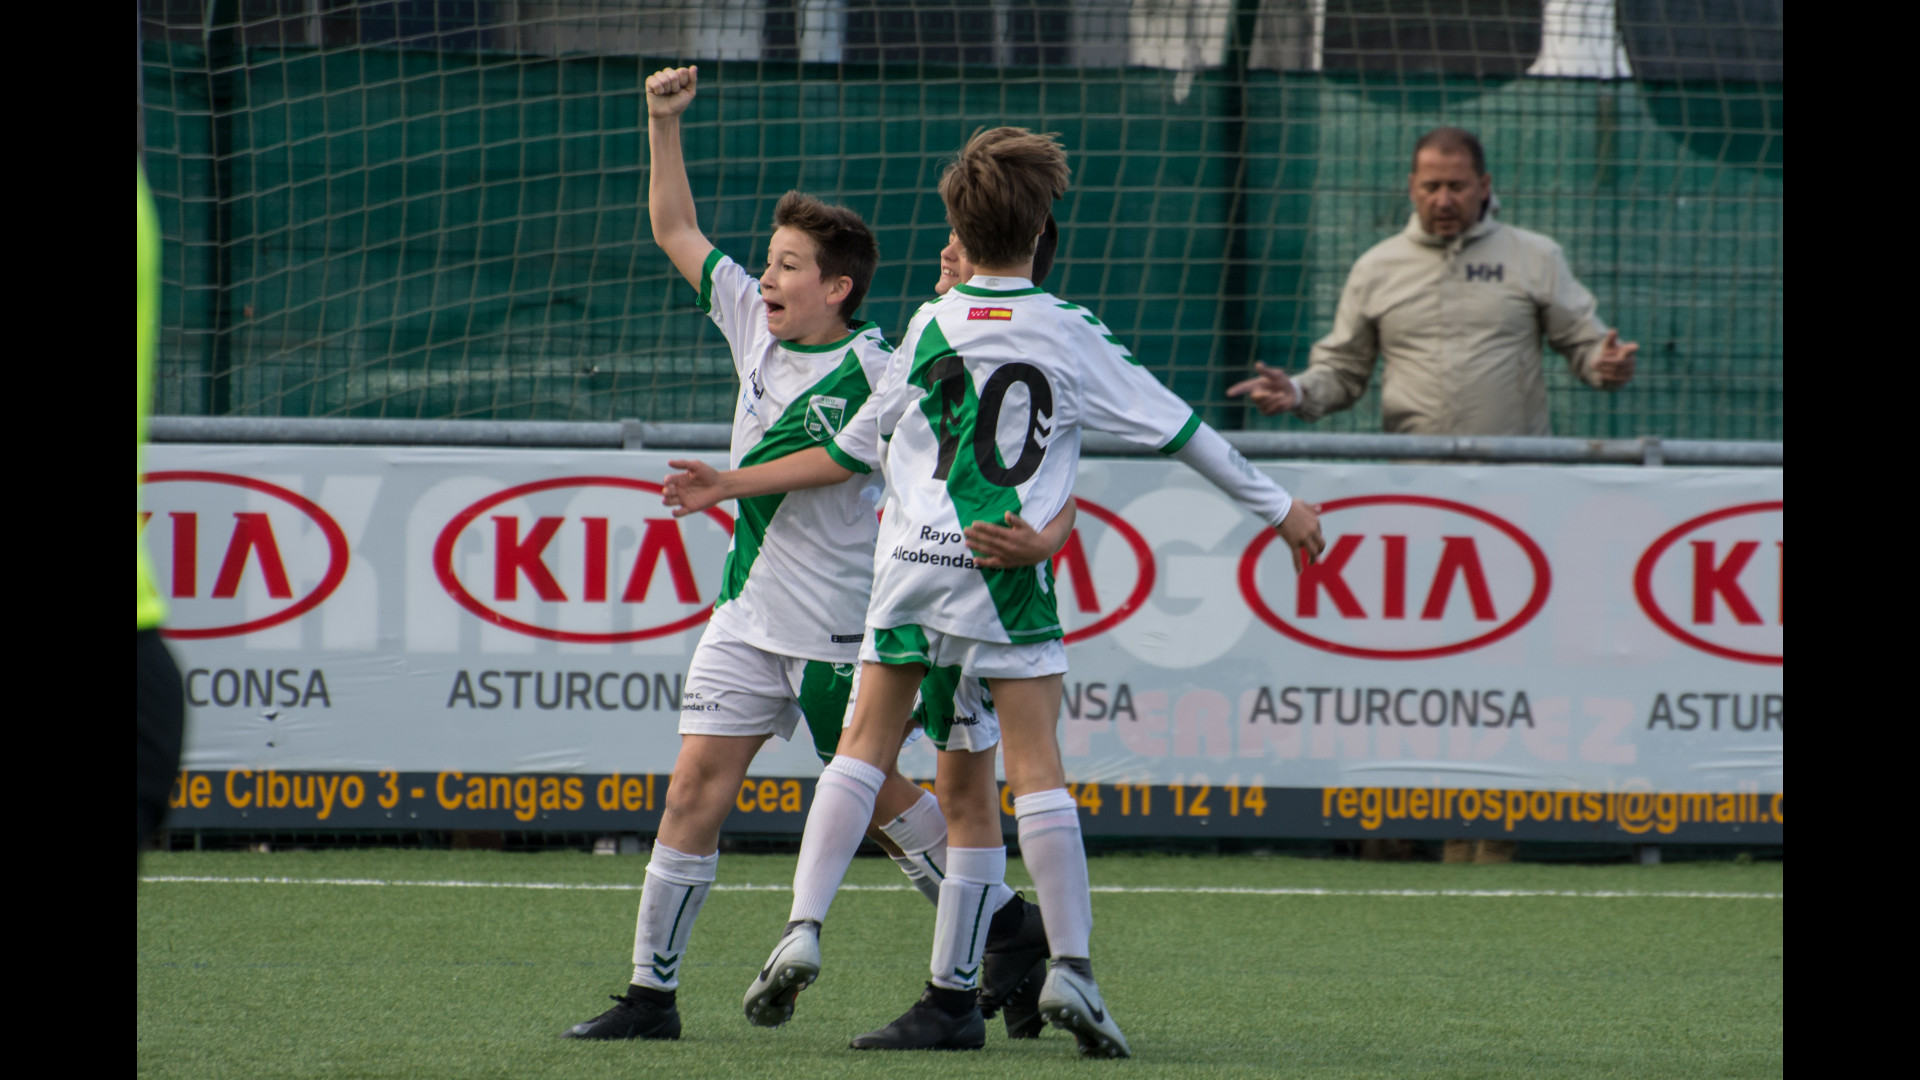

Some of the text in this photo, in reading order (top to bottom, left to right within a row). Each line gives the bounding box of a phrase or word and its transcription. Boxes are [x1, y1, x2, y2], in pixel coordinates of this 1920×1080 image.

[1466, 264, 1504, 282] HH
[926, 356, 1053, 487] 10
[137, 511, 293, 599] IA
[920, 525, 962, 545] Rayo
[491, 515, 702, 604] KIA
[1296, 534, 1498, 621] KIA
[186, 668, 331, 708] CONSA
[447, 670, 685, 712] ASTURCON
[1249, 686, 1535, 728] ASTURCONSA
[168, 767, 212, 809] de
[225, 767, 364, 820] Cibuyo
[378, 767, 399, 809] 3
[436, 769, 585, 821] Cangas
[597, 770, 654, 811] del
[1115, 774, 1151, 816] 11
[1169, 774, 1211, 816] 12
[1224, 775, 1267, 817] 14
